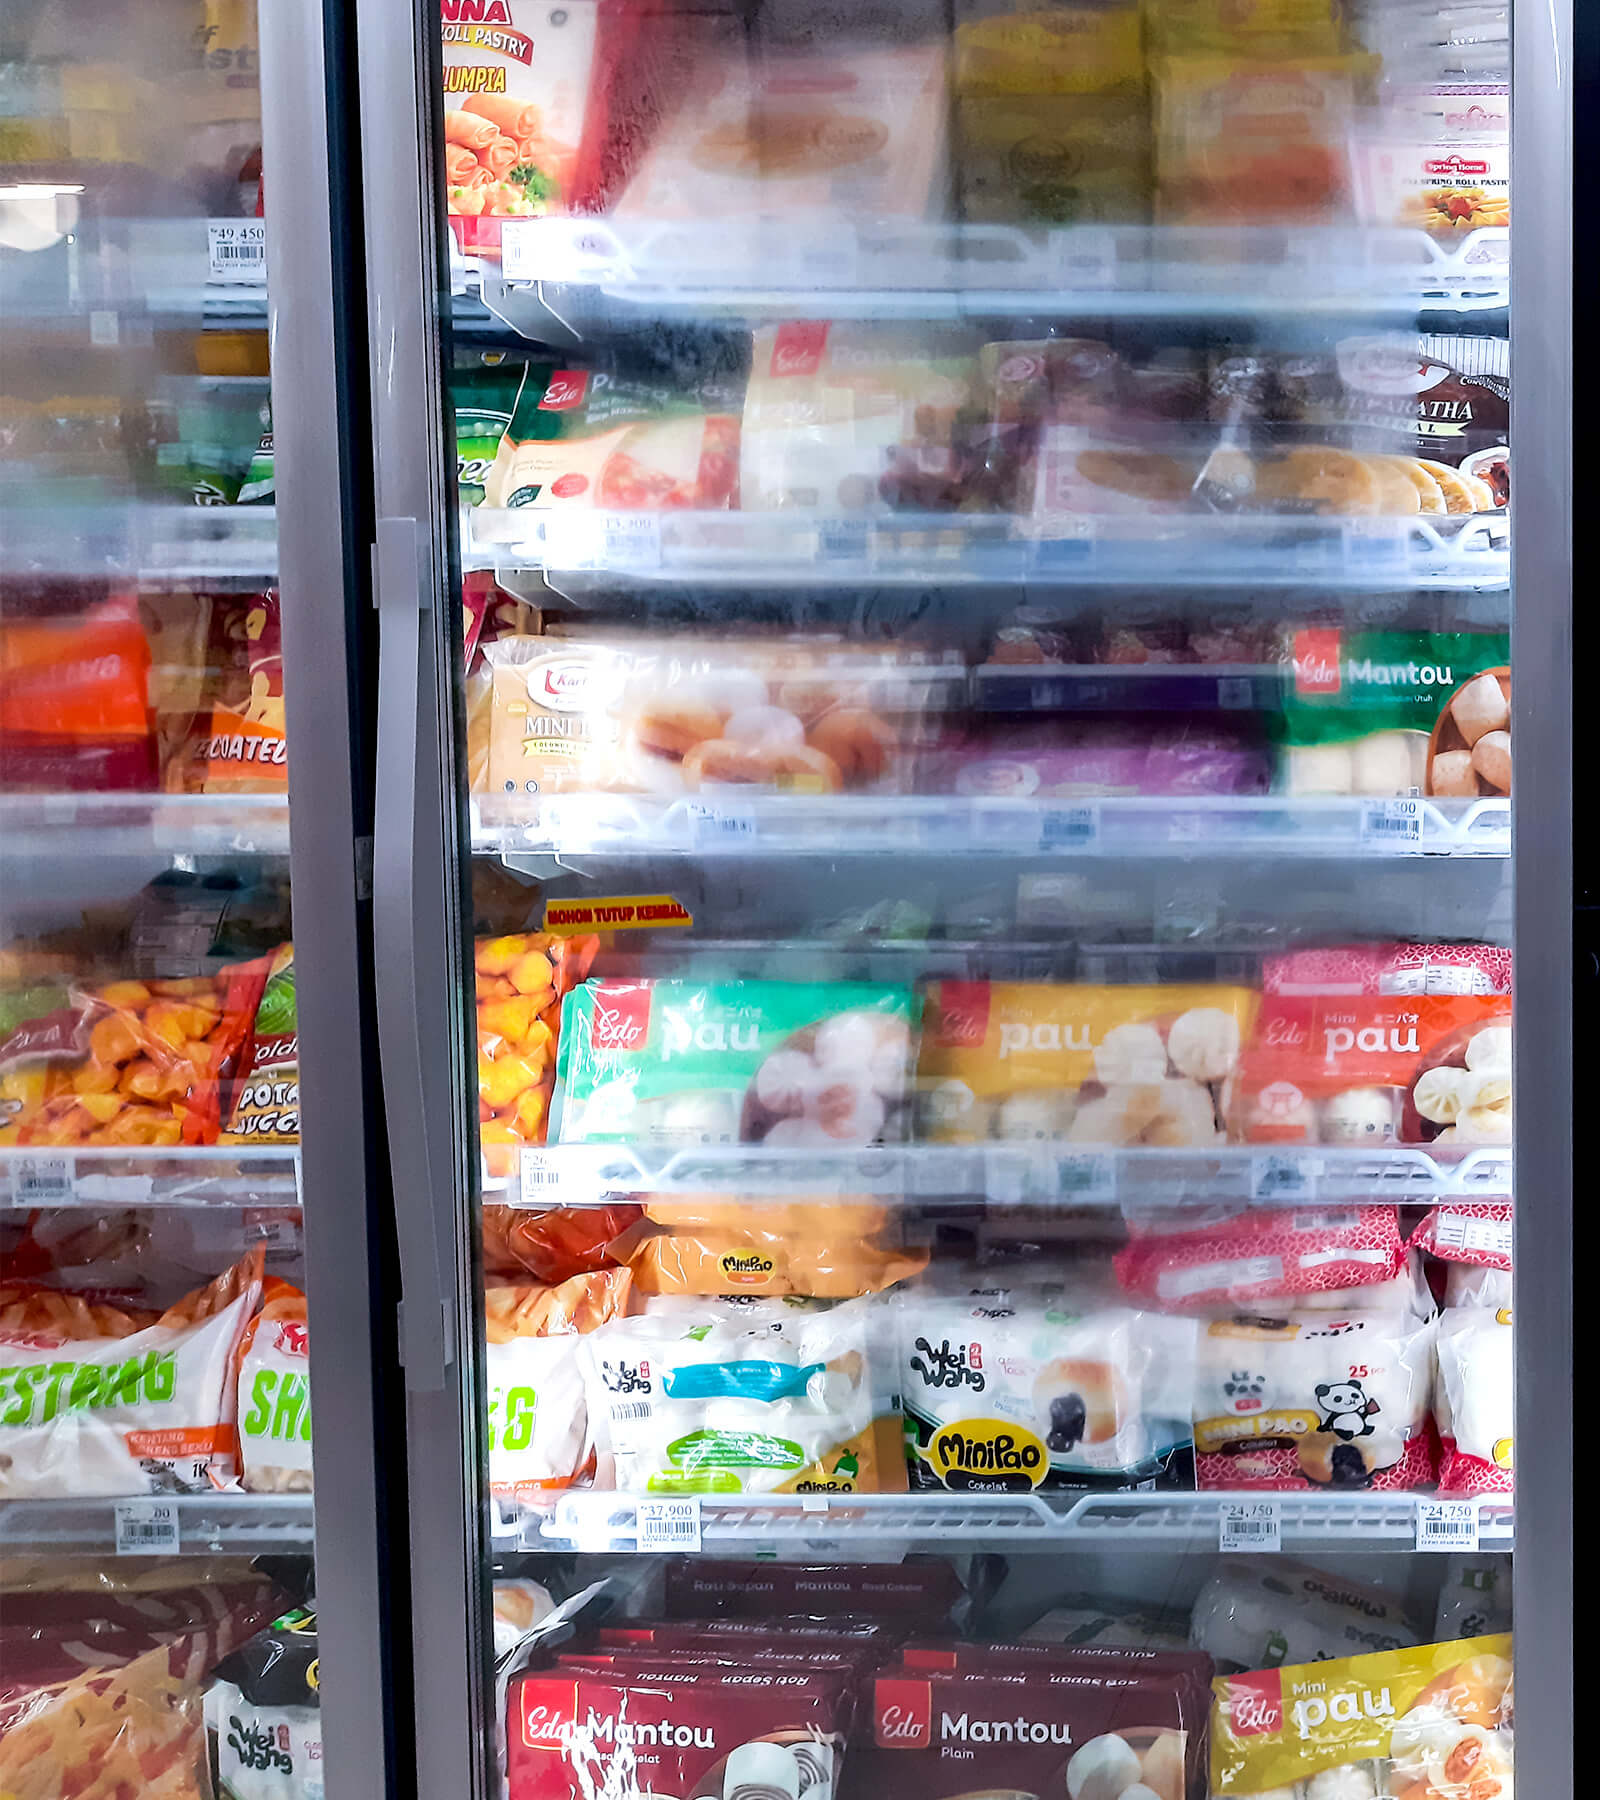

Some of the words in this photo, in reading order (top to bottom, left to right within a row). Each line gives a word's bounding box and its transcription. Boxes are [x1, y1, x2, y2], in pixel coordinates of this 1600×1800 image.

[441, 26, 470, 43] OLL
[473, 28, 529, 58] PASTRY
[1349, 659, 1454, 686] Mantou
[548, 907, 593, 925] MOHON
[594, 906, 635, 923] TUTUP
[599, 1009, 644, 1042] Edo
[1000, 1022, 1095, 1058] pau
[1323, 1025, 1421, 1063] pau
[915, 1336, 966, 1368] Wei
[910, 1356, 985, 1392] Wang
[1349, 1365, 1369, 1378] 25
[938, 1433, 1041, 1470] MiniPao
[967, 1479, 1008, 1492] Cokelat
[648, 1504, 693, 1517] 37,900
[1229, 1505, 1273, 1518] 24,750
[1428, 1505, 1472, 1518] 24,750
[636, 1672, 699, 1684] Mantou
[1292, 1681, 1327, 1695] Mini
[881, 1705, 924, 1739] Edo
[940, 1711, 1072, 1745] Mantou
[1293, 1686, 1396, 1741] pau
[588, 1713, 715, 1749] Mantou
[228, 1733, 294, 1776] Wang
[941, 1746, 975, 1761] Plain
